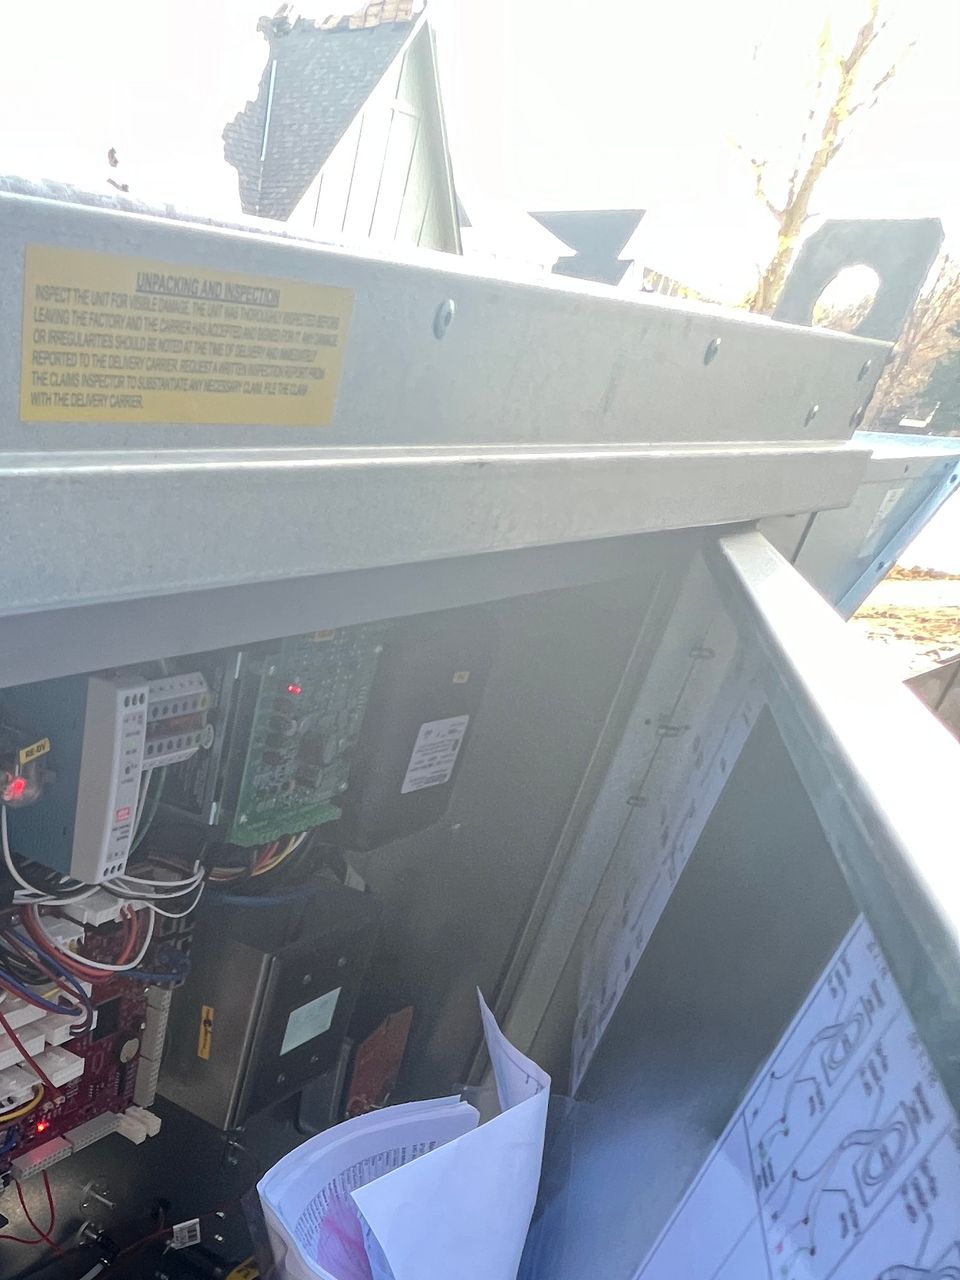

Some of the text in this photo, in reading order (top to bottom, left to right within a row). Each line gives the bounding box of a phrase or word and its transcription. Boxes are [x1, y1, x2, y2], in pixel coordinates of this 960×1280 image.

[135, 273, 280, 306] UNPACKING AND INSPECTION
[32, 327, 46, 343] OR
[114, 334, 145, 350] SHOULD
[31, 349, 77, 366] REPORTED
[78, 352, 90, 367] TO
[90, 353, 108, 368] THE
[108, 354, 144, 370] DELIVERY
[31, 370, 49, 385] THE
[49, 371, 80, 386] CLAIMS
[81, 372, 125, 388] INSPECTOR
[125, 375, 137, 388] TO
[30, 391, 52, 406] WITH
[52, 392, 71, 406] THE
[70, 392, 107, 407] DELIVERY
